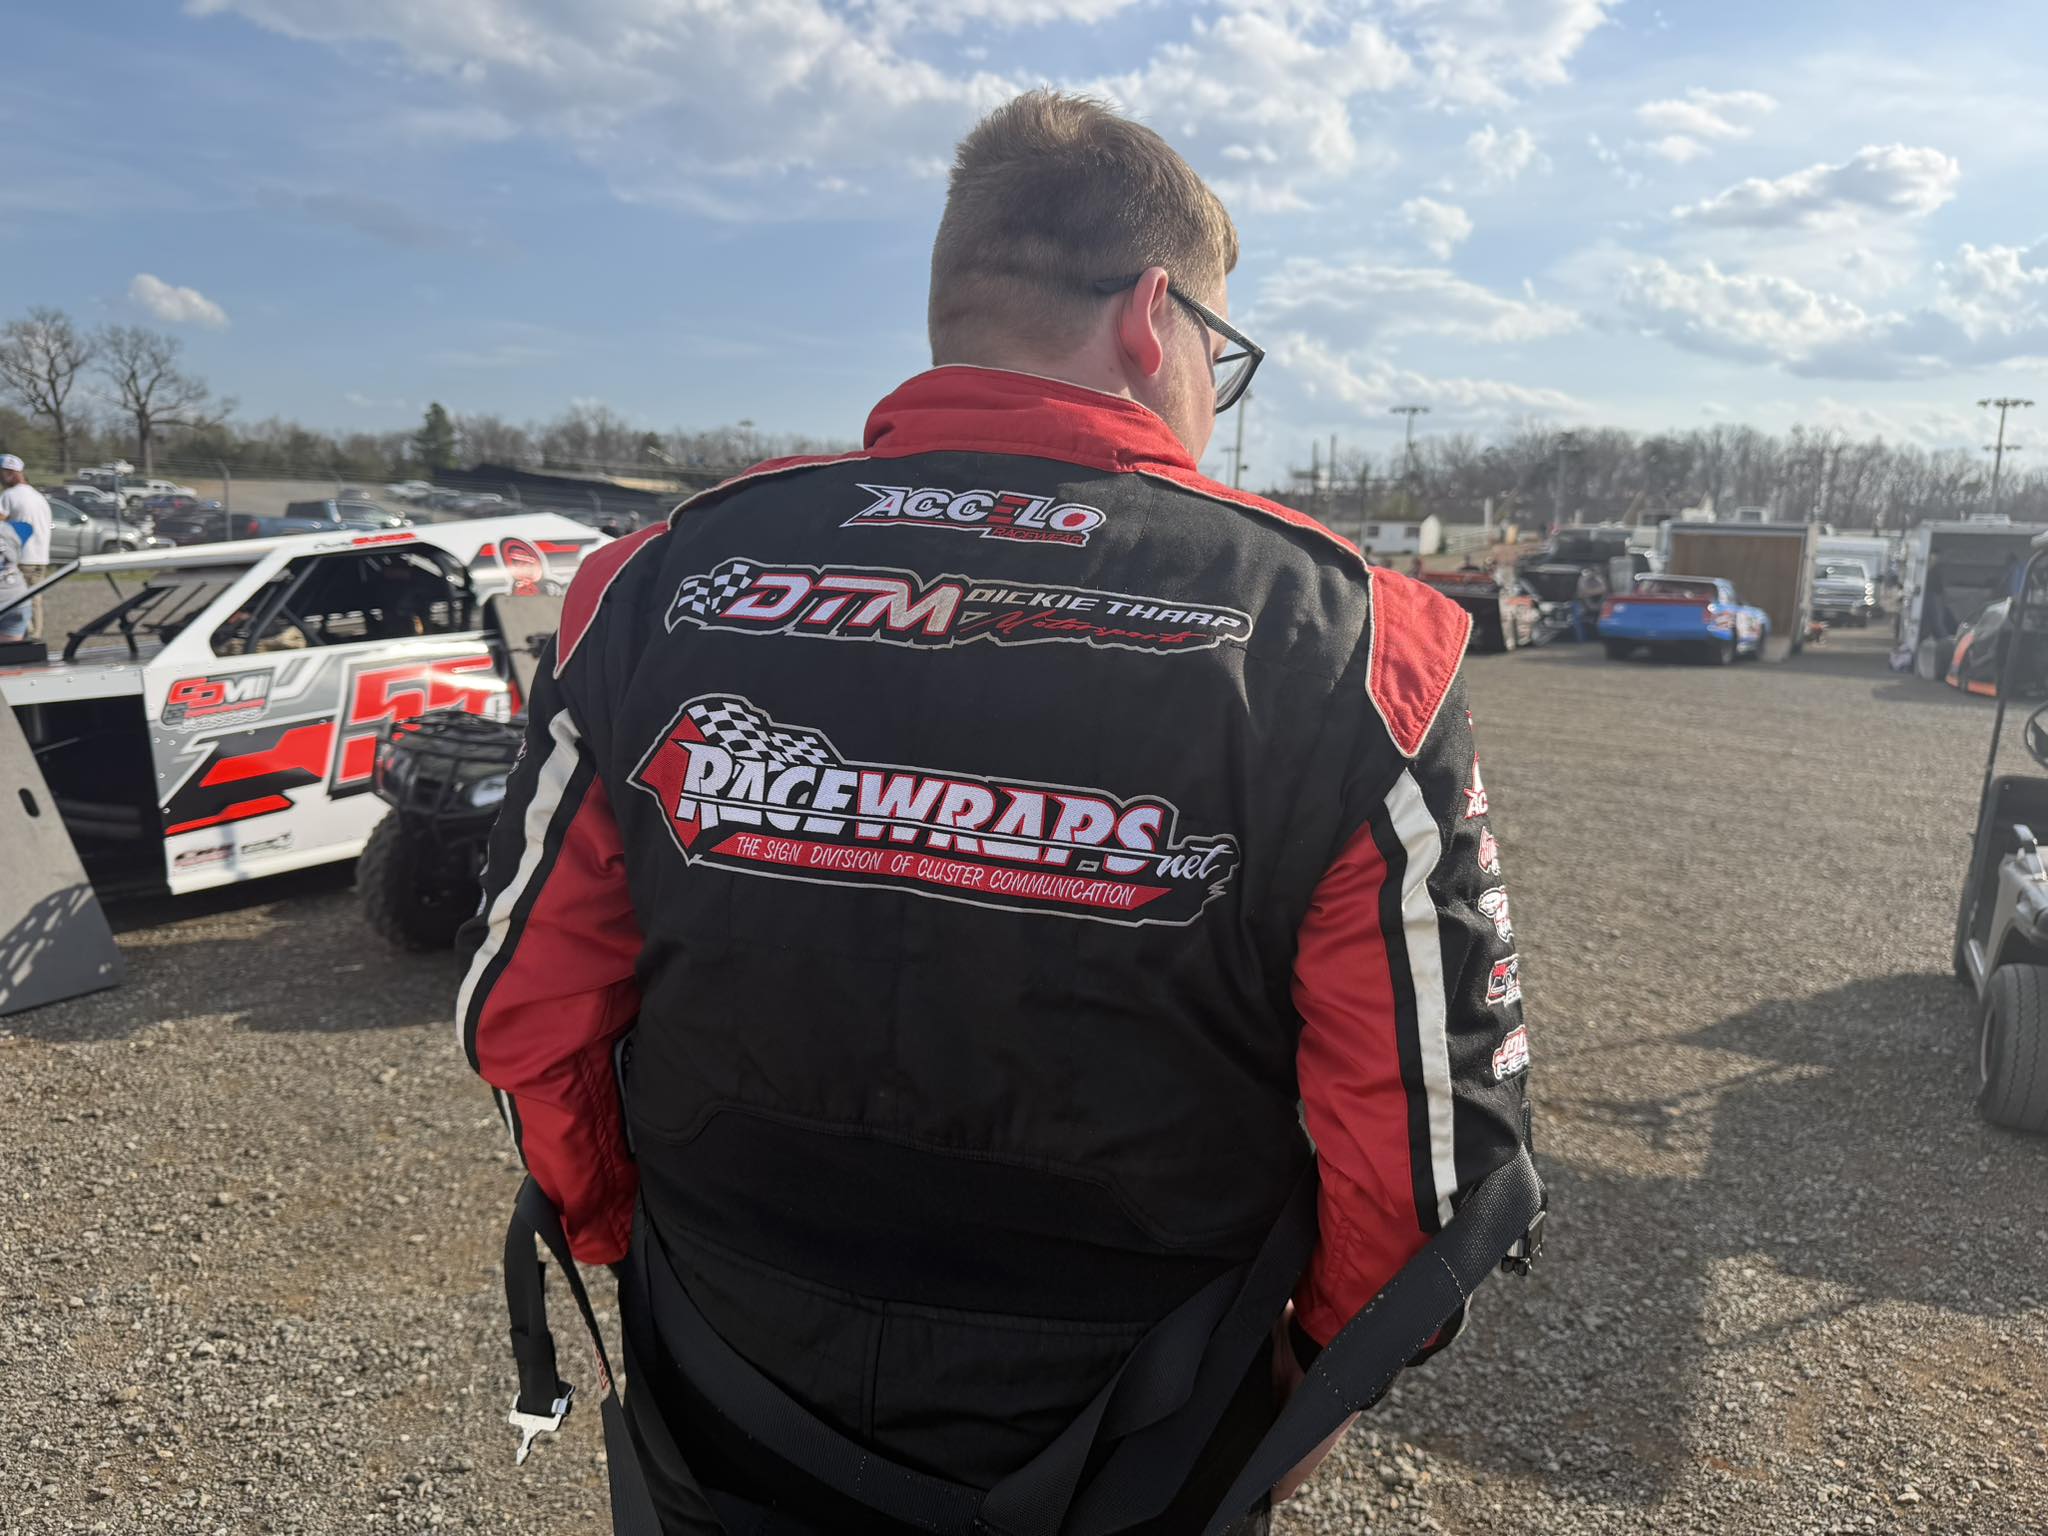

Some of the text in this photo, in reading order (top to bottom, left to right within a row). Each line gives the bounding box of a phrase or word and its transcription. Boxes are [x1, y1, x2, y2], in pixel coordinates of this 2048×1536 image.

[862, 488, 1100, 531] ACCELO
[991, 527, 1084, 545] RACEWEAR
[718, 572, 965, 637] DTM
[963, 588, 1243, 629] DICKIE THARP
[736, 836, 1137, 906] THE SIGN DIVISION OF CLUSTER COMMUNICATION
